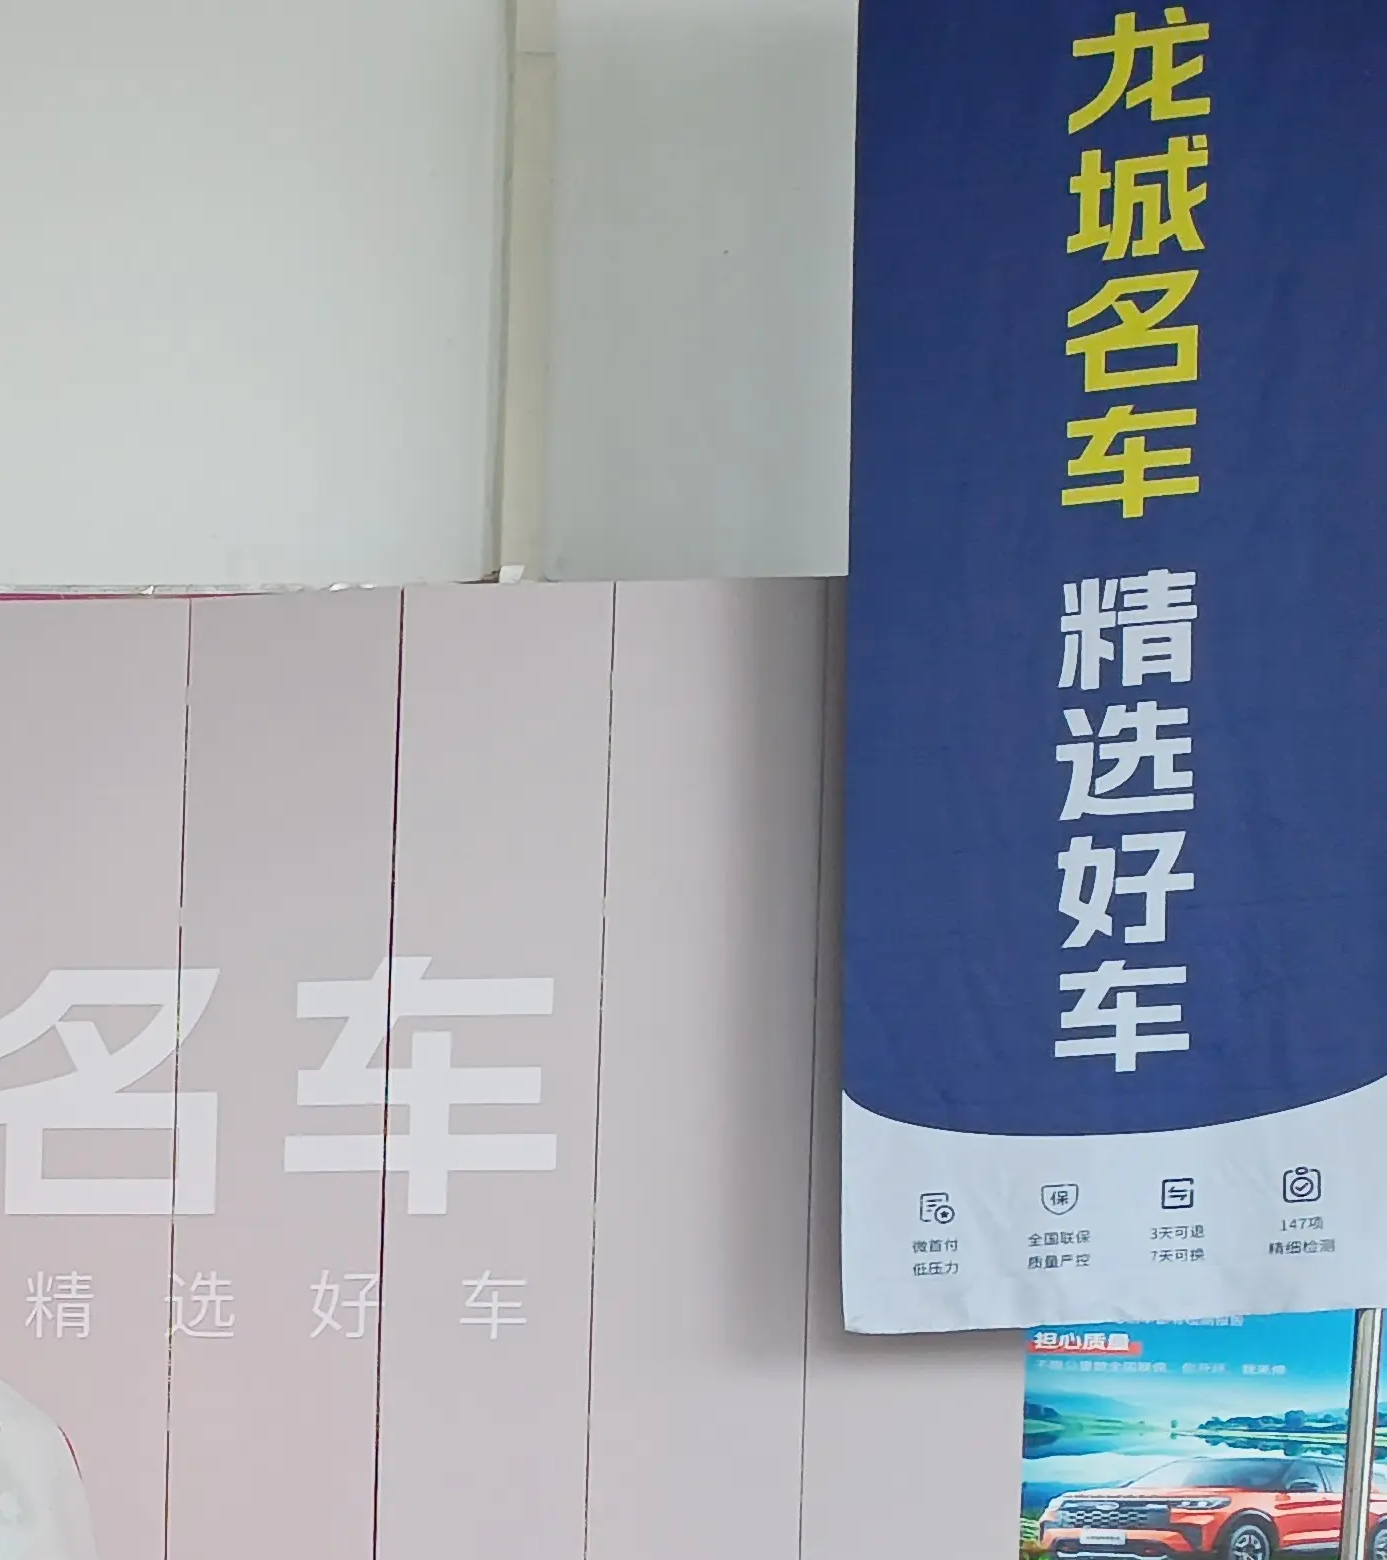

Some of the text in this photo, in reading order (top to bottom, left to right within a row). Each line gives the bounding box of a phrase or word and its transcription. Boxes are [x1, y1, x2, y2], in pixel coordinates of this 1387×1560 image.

[1054, 6, 1211, 1073] 龙城名车 精选好车
[1150, 1224, 1205, 1240] 3天可退
[1280, 1216, 1324, 1232] 147项
[912, 1239, 959, 1254] 微首付
[1028, 1231, 1091, 1247] 全国联保
[913, 1261, 959, 1276] 低压力
[25, 1269, 527, 1341] 精选好车
